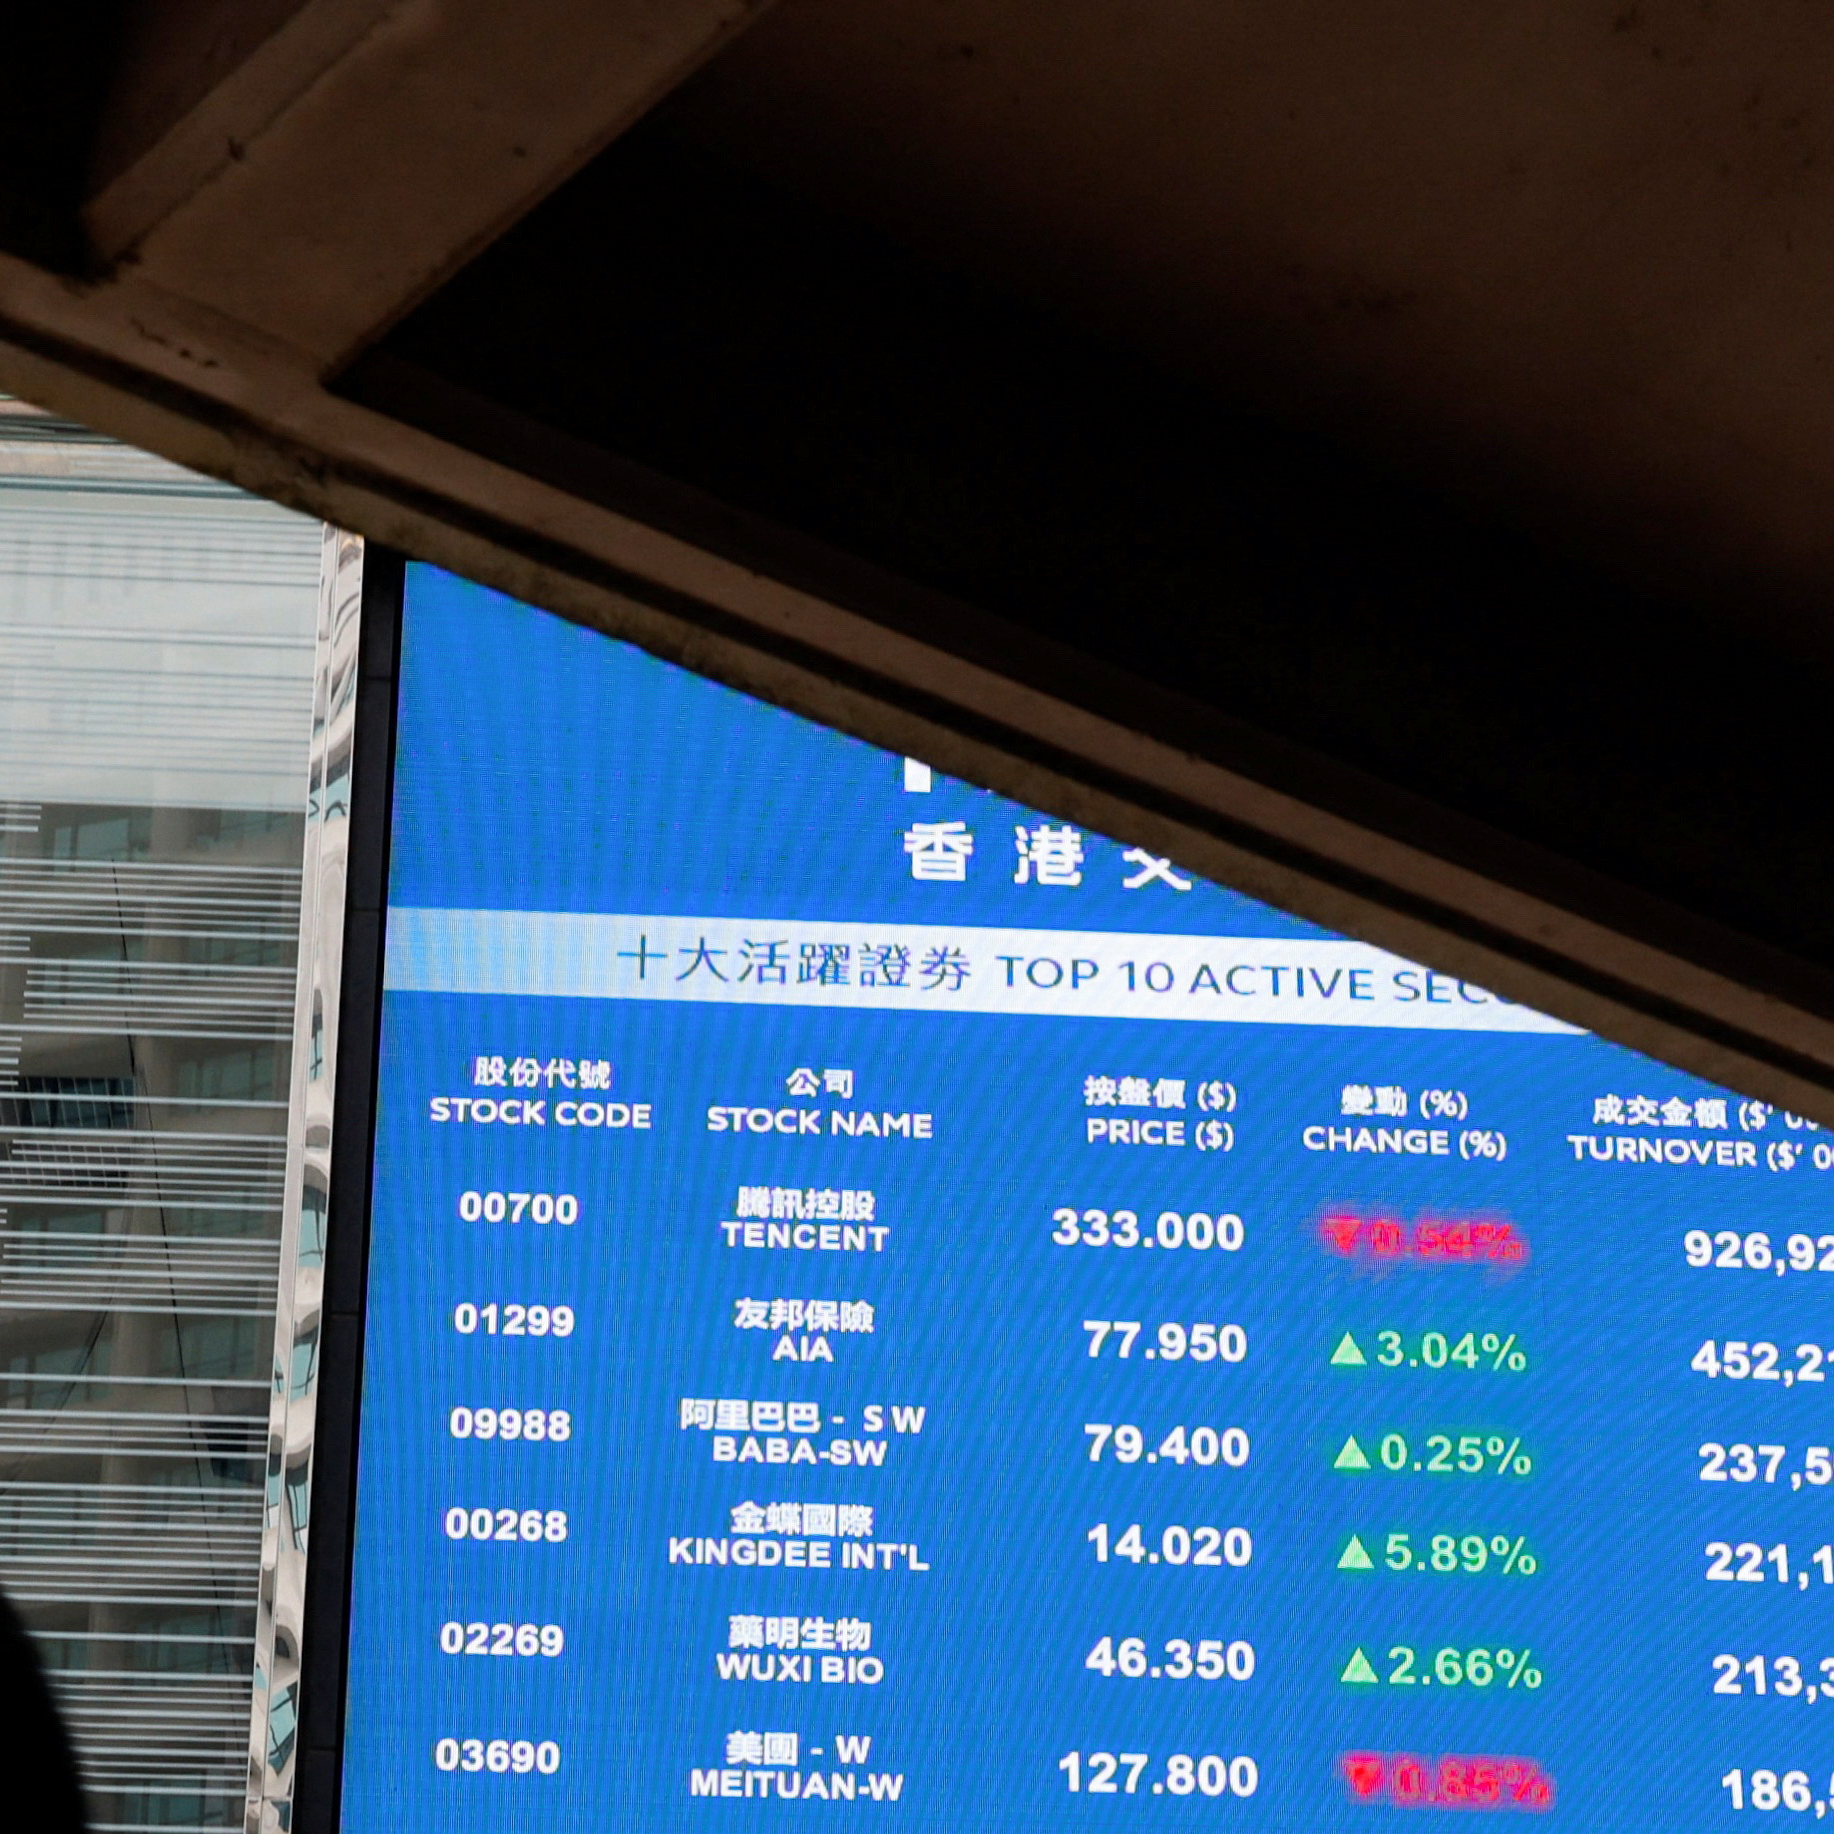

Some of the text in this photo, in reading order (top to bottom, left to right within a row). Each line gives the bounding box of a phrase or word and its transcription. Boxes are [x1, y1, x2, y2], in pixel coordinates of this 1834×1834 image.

[616, 933, 974, 994] 十大活躍證券
[996, 951, 1100, 993] TOP
[1119, 958, 1176, 993] 10
[1187, 961, 1376, 1002] ACTIVE
[474, 1057, 611, 1089] 股份代號
[787, 1069, 853, 1098] 公司
[431, 1098, 651, 1128] STOCK CODE
[1198, 1082, 1236, 1111] ($)
[1342, 1085, 1467, 1119] 變動 (%)
[1594, 1095, 1727, 1128] 成交金額
[708, 1107, 932, 1137] STOCK NAME
[1088, 1119, 1233, 1150] PRICE ($)
[1304, 1127, 1506, 1160] CHANGE (%)
[1568, 1136, 1756, 1166] TURNOVER
[460, 1192, 578, 1224] 00700
[736, 1187, 875, 1220] 騰訊控股
[721, 1221, 889, 1251] TENCENT
[1053, 1209, 1244, 1250] 333.000
[455, 1304, 574, 1336] 01299
[735, 1298, 874, 1334] 友邦保險
[773, 1335, 833, 1361] AIA
[1084, 1321, 1246, 1362] 77.950
[1378, 1332, 1526, 1370] 3.04%
[451, 1407, 570, 1441] 09988
[681, 1399, 820, 1432] 阿里巴巴
[713, 1436, 887, 1465] BABA-SW
[1085, 1425, 1249, 1466] 79.400
[1382, 1435, 1532, 1475] 0.25%
[445, 1508, 567, 1542] 00268
[731, 1501, 873, 1537] 金蝶國際
[670, 1537, 929, 1570] KINGDEE INT'L
[1088, 1524, 1252, 1566] 14.020
[1387, 1535, 1537, 1575] 5.89%
[441, 1622, 563, 1656] 02269
[729, 1615, 871, 1651] 藥明生物
[717, 1654, 883, 1684] WUXI BIO
[1086, 1637, 1254, 1680] 46.350
[1389, 1647, 1542, 1689] 2.66%
[436, 1739, 559, 1773] 03690
[727, 1731, 870, 1765] 美團 W
[691, 1769, 903, 1800] MEITUAN-W
[1060, 1752, 1257, 1796] 127.800
